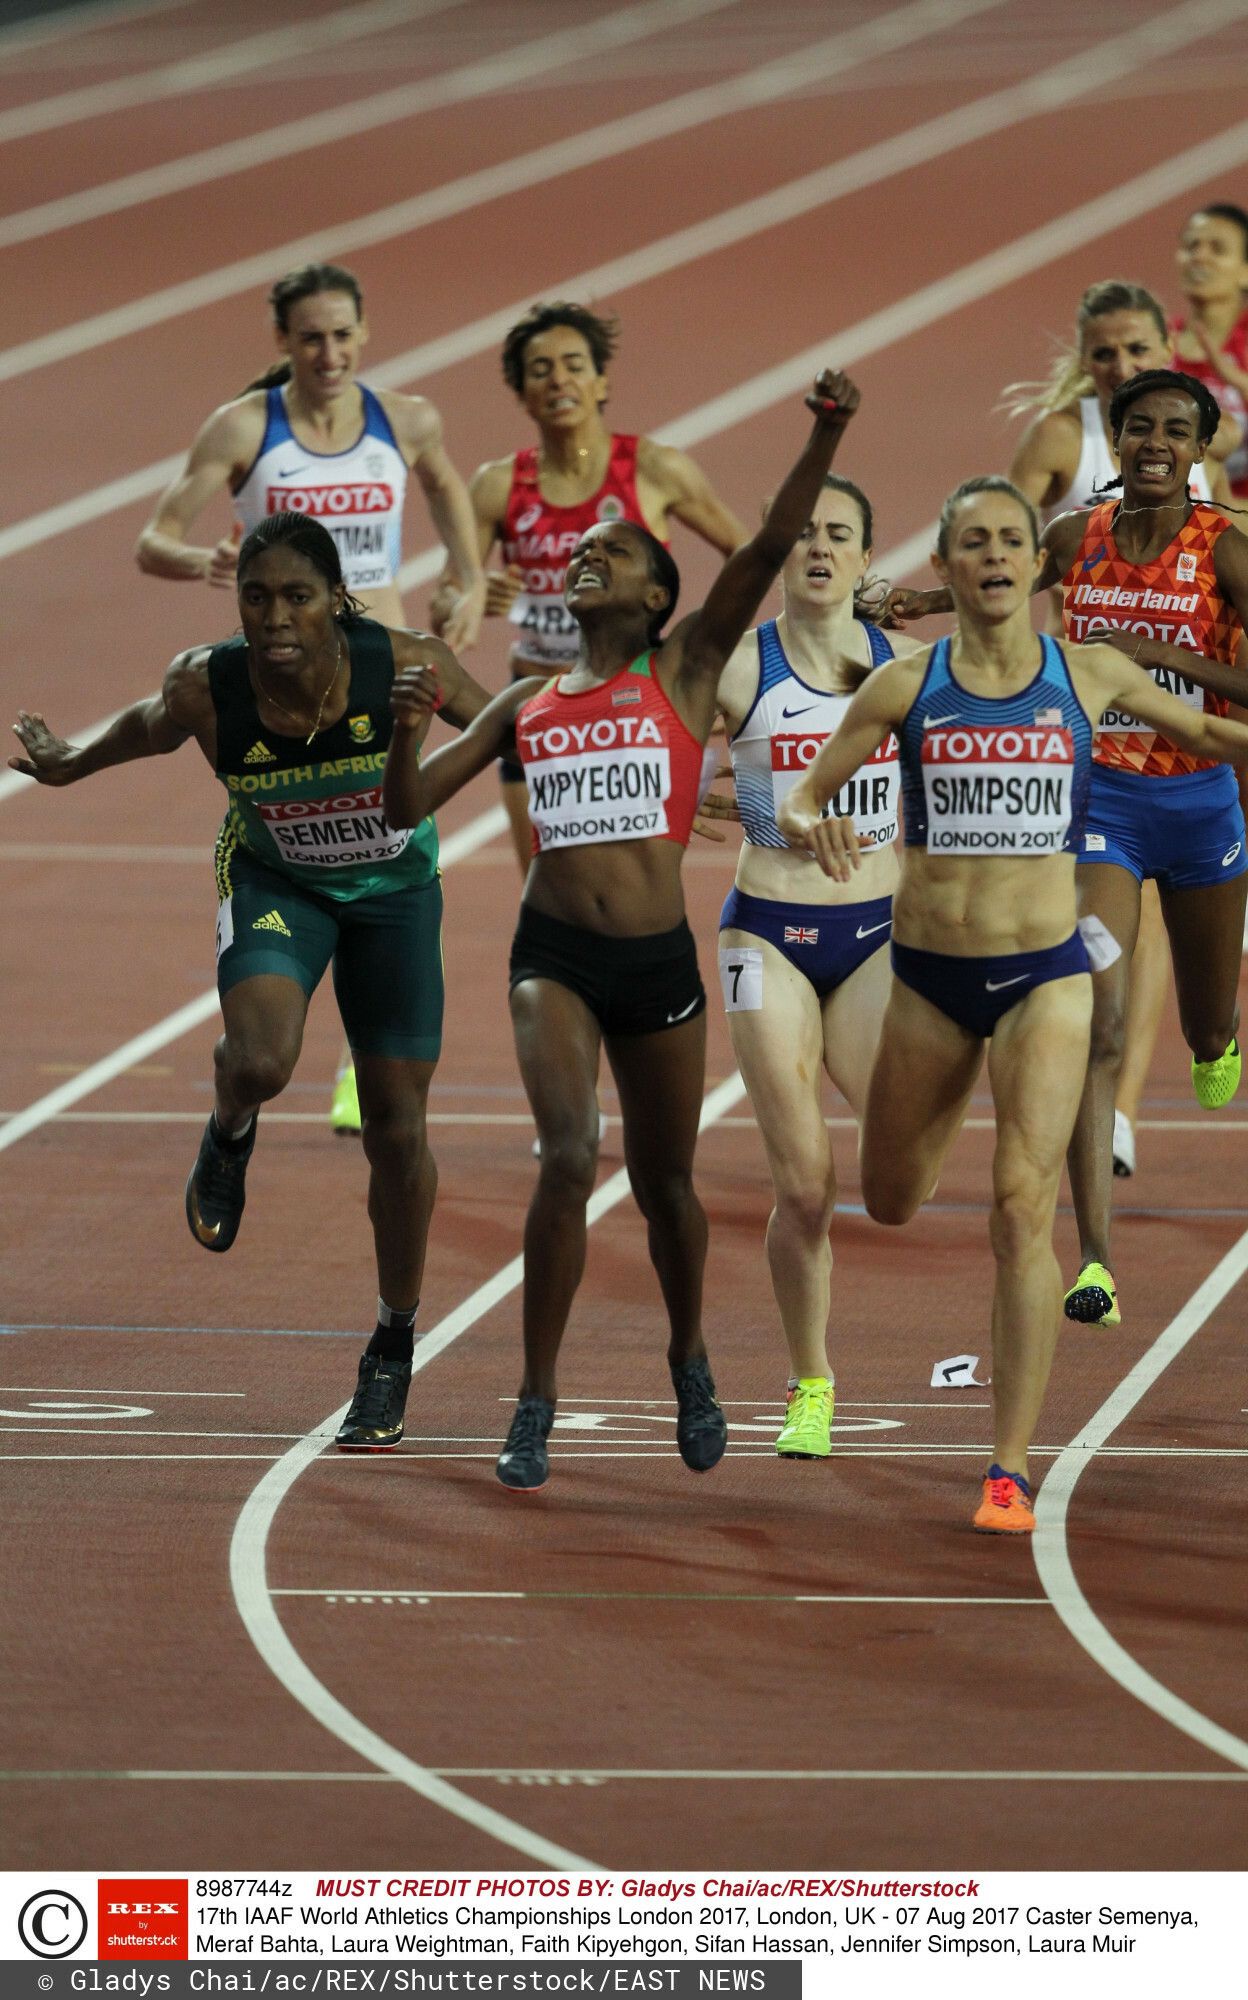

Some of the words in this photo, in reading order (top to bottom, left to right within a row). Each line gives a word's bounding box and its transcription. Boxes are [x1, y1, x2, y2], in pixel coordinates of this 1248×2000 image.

[271, 487, 389, 513] TOYOTA
[330, 523, 387, 556] TMAN
[1153, 666, 1195, 696] AN
[521, 717, 663, 757] TOYOTA
[927, 731, 1069, 760] TOYOTA
[227, 766, 314, 793] SOUTH
[319, 752, 388, 779] AFRIC
[243, 754, 278, 764] adidas
[533, 762, 662, 812] KIPYEGON
[821, 776, 890, 819] UIR
[932, 777, 1063, 816] SIMPSON
[260, 790, 385, 820] TOYOT
[275, 814, 390, 846] SEMENY
[932, 831, 1017, 848] LONDON
[286, 850, 372, 864] LONDON
[252, 921, 292, 938] adidas
[727, 964, 744, 1003] 7
